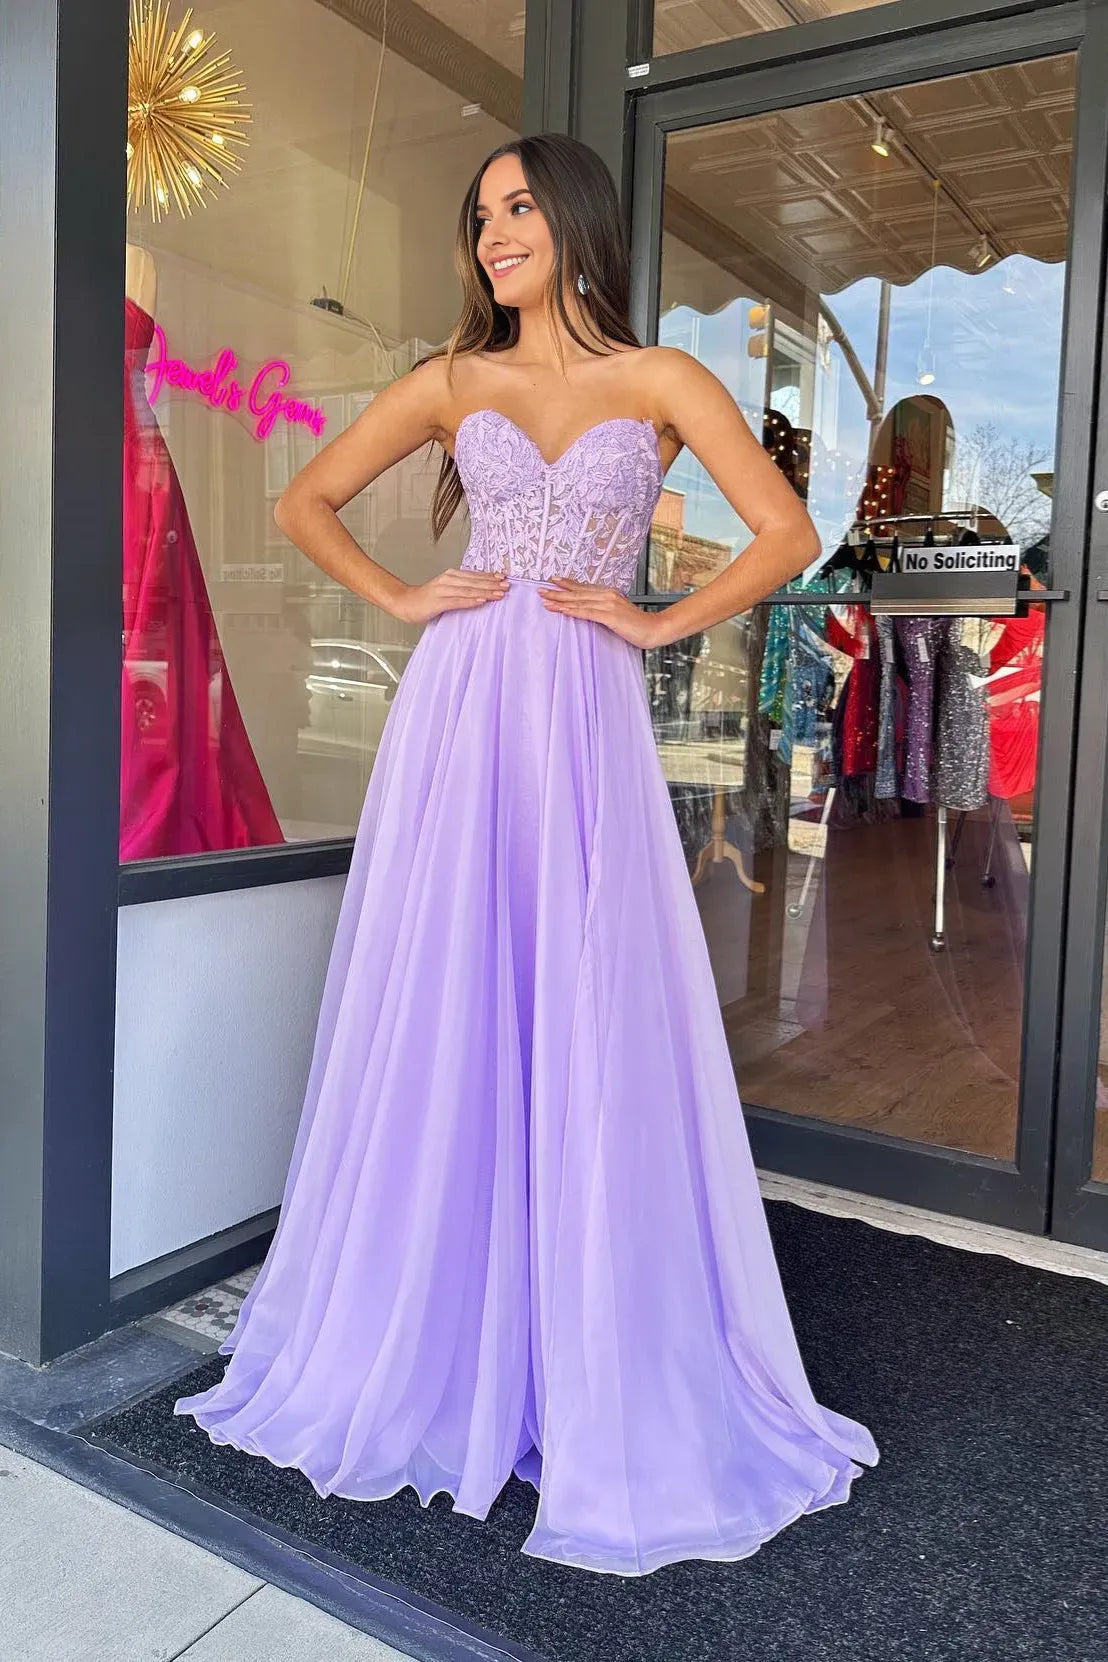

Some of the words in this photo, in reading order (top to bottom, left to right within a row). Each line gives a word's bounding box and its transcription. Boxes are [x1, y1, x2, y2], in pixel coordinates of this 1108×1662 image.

[250, 361, 327, 439] Gems
[905, 553, 928, 570] No
[933, 551, 1017, 570] Soliciting
